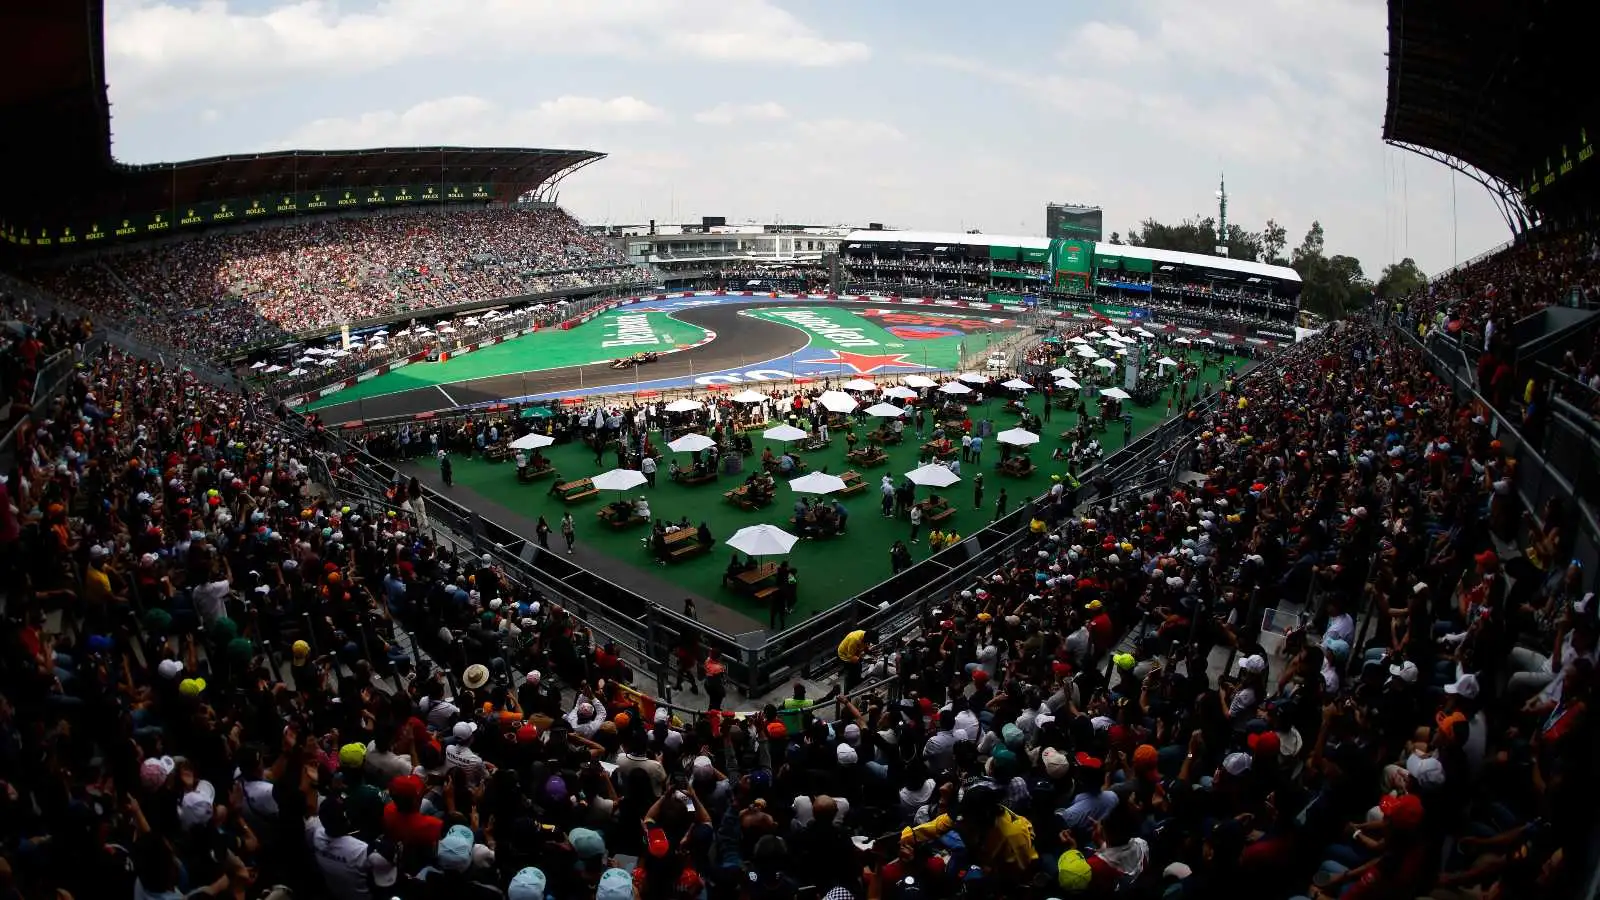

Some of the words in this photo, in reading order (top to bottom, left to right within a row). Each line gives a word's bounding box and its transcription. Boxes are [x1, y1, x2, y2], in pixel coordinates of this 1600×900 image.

[213, 211, 234, 220] ROLEX
[246, 207, 266, 216] ROLEX
[768, 311, 880, 348] Heineken
